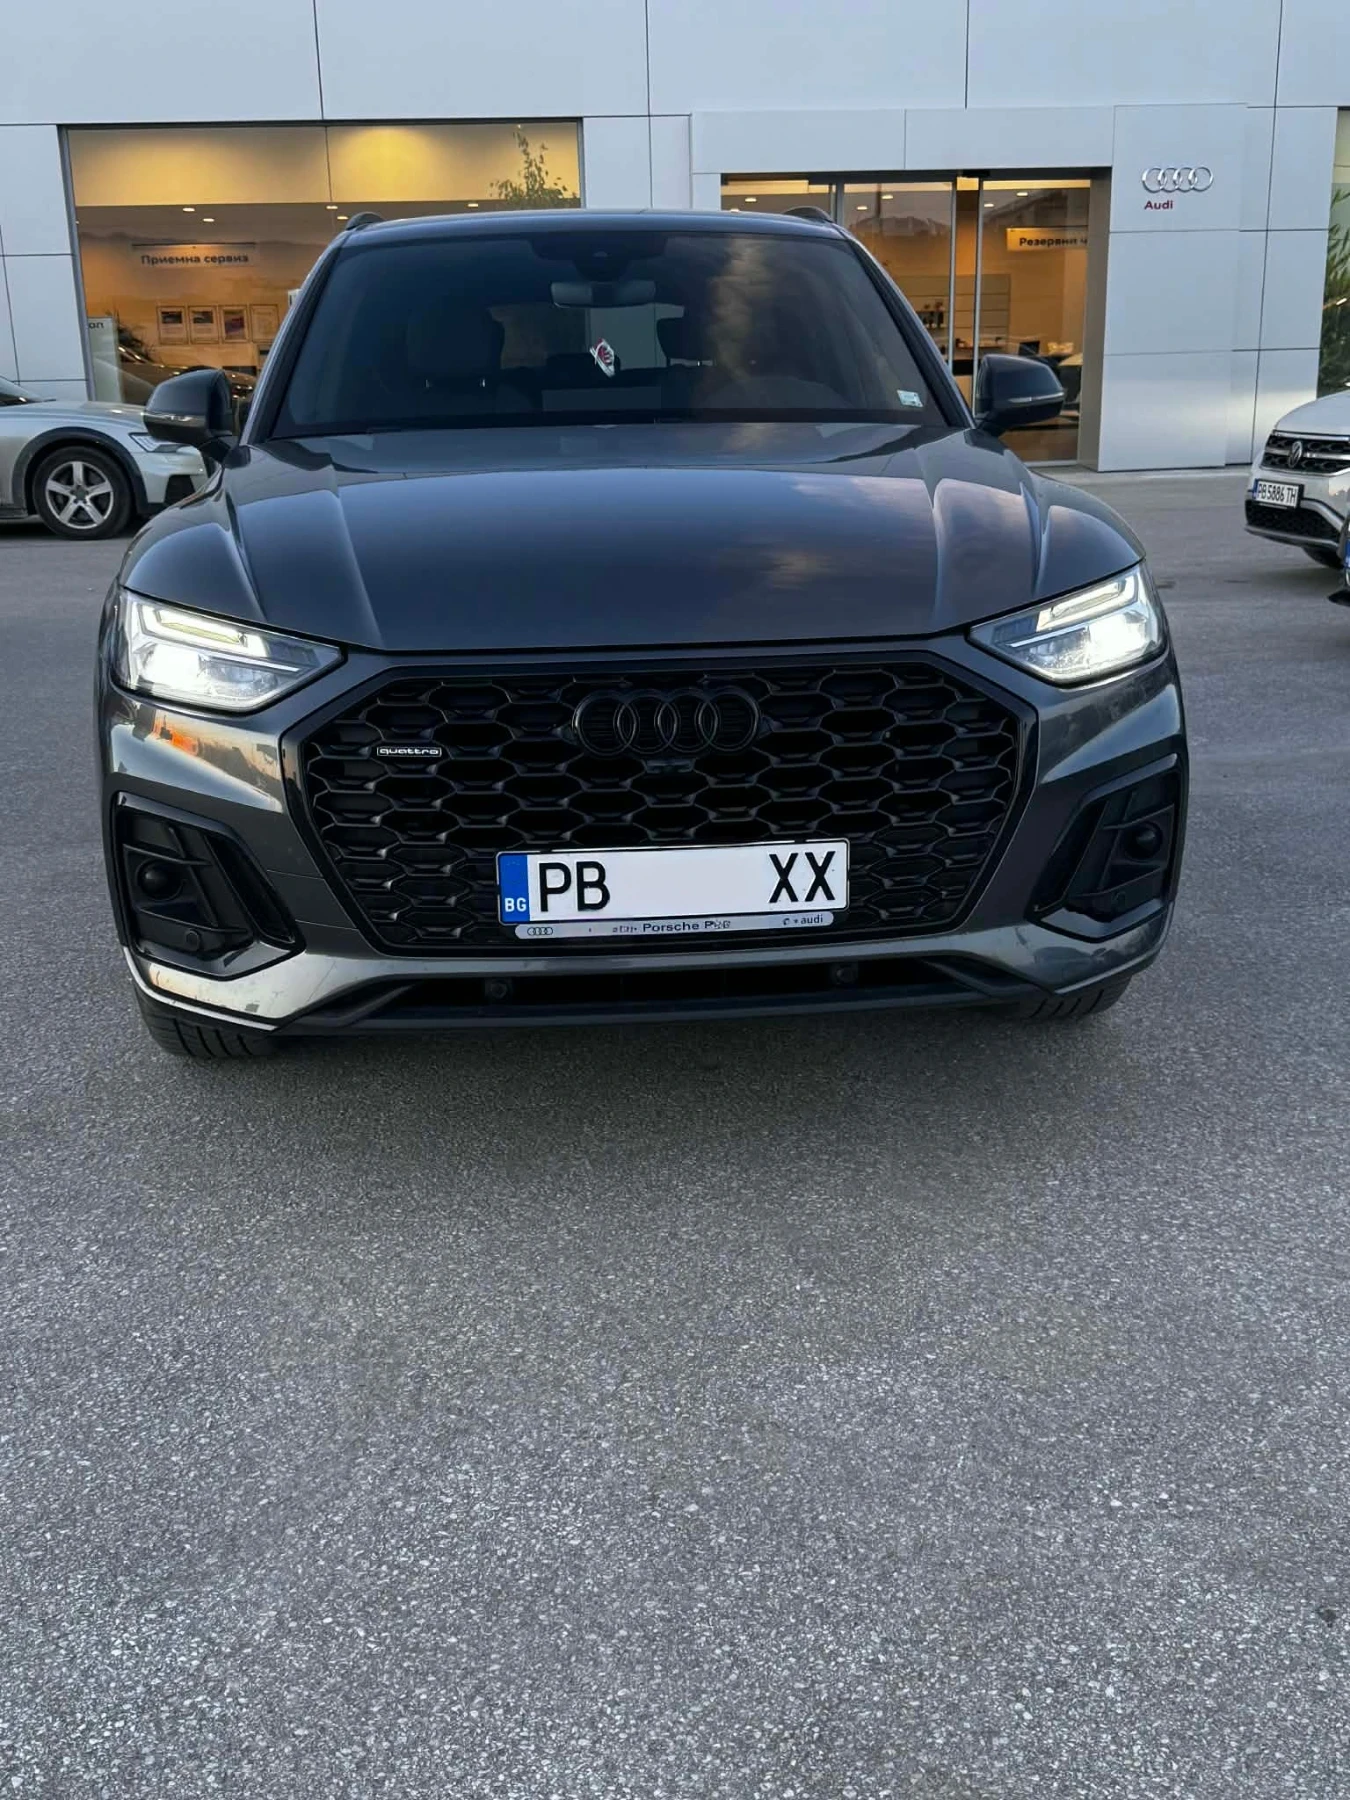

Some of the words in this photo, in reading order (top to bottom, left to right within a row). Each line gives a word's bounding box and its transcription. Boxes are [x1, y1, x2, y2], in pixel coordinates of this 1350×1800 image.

[1144, 200, 1174, 210] Audi
[1019, 237, 1077, 248] Резервни
[140, 254, 201, 266] Приемна
[203, 254, 249, 264] сервиз
[1286, 487, 1297, 504] TH
[379, 747, 439, 755] quattro
[538, 861, 611, 912] PB
[768, 850, 836, 903] XX
[504, 897, 527, 912] BG
[800, 914, 823, 925] audi
[642, 921, 700, 932] Porsche
